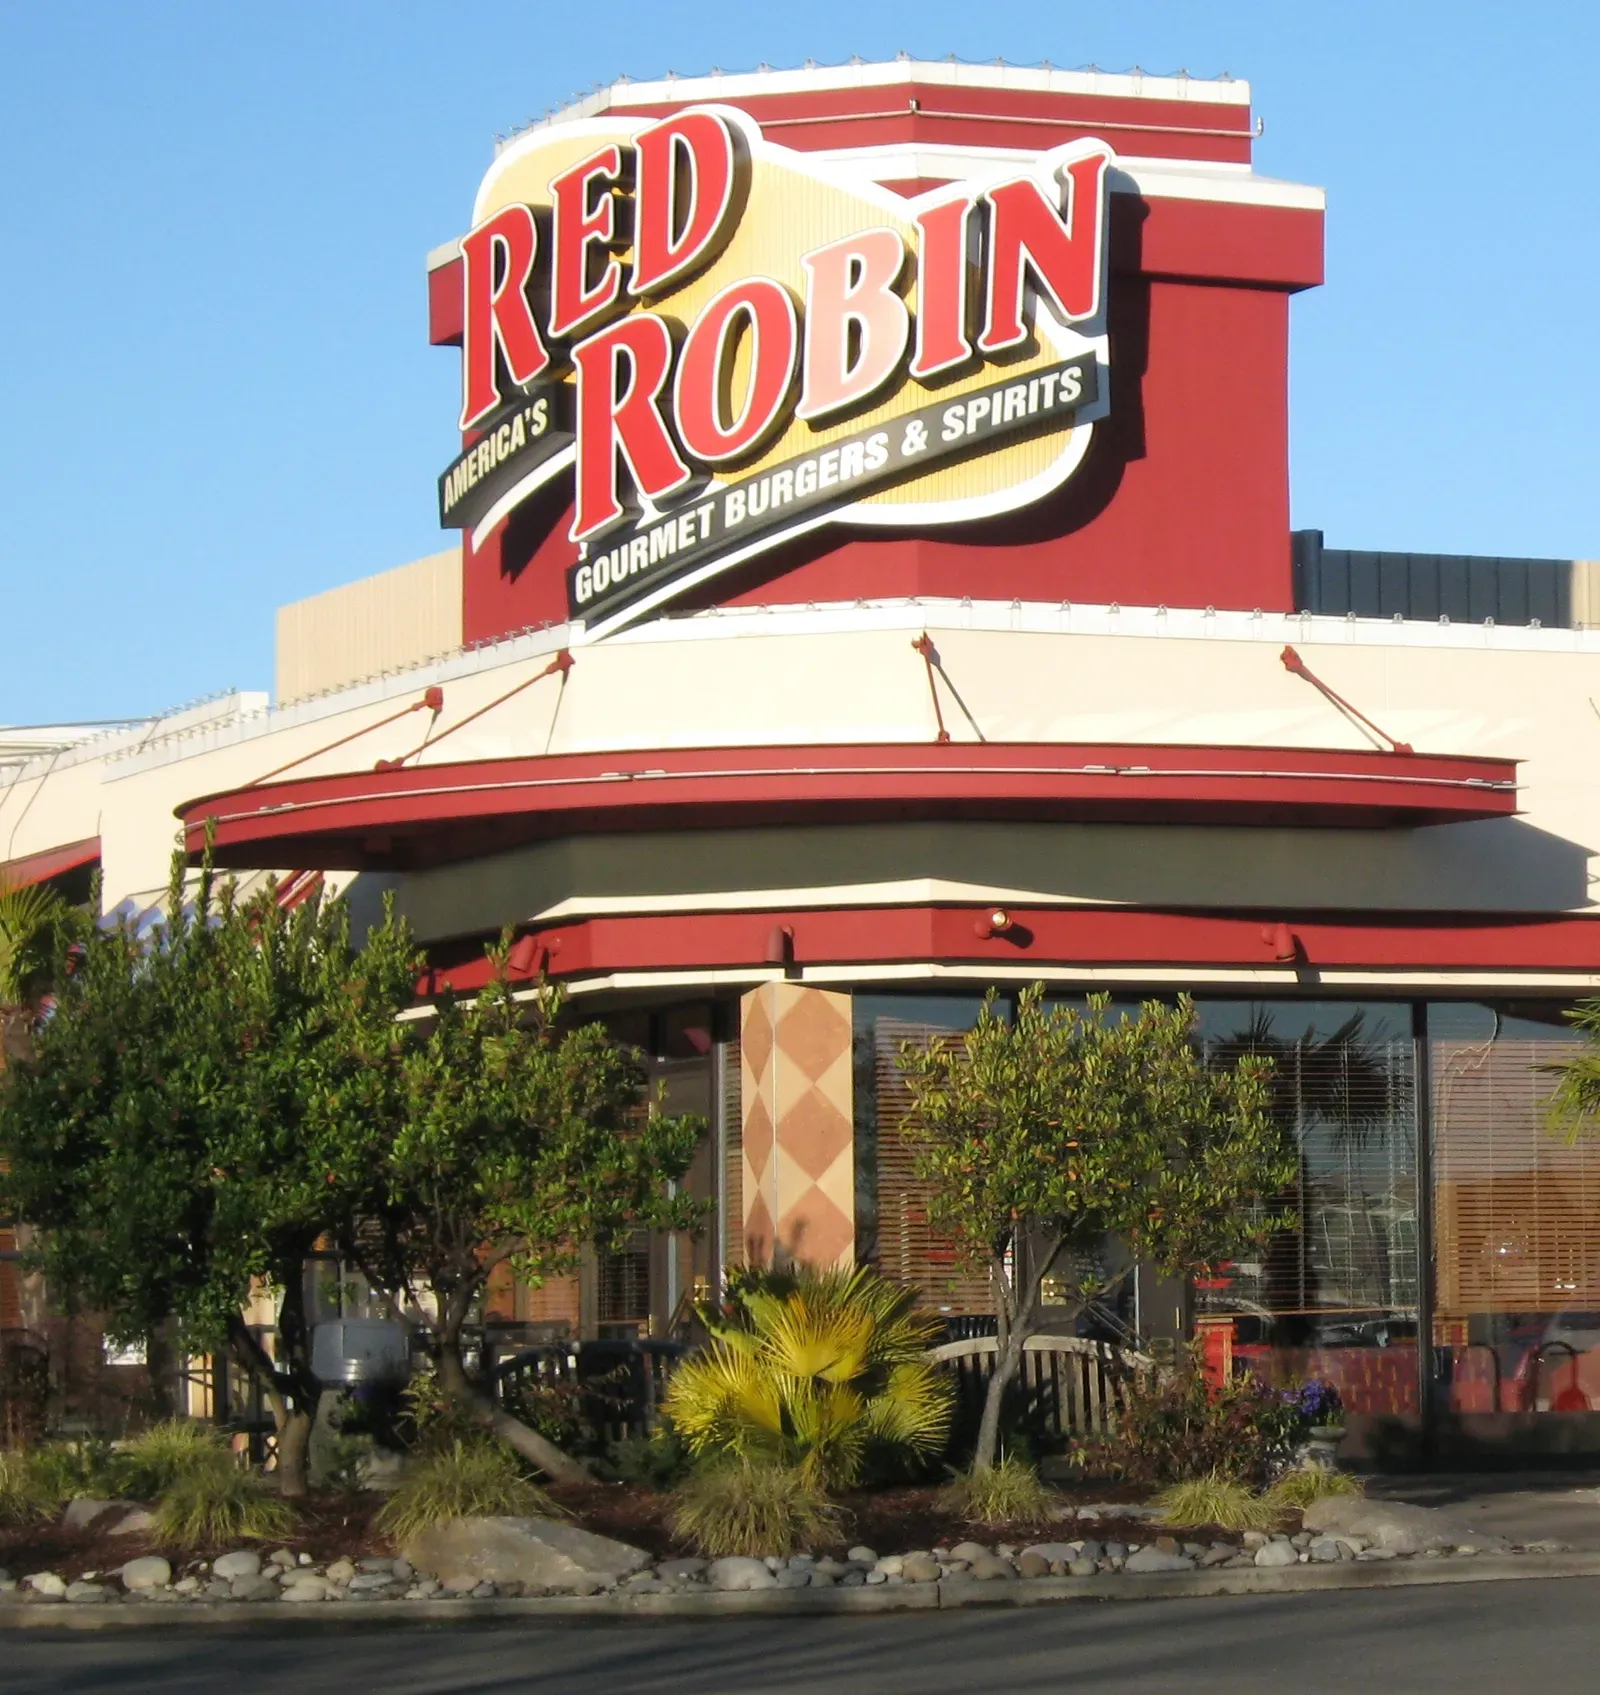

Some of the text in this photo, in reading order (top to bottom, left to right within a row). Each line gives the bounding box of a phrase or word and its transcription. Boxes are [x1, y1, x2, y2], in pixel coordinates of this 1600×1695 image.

[459, 109, 734, 431] RED
[568, 150, 1112, 543] ROBIN
[443, 398, 549, 514] AMERICA'S
[574, 366, 1083, 604] GOURMET BURGERS & SPIRITS
